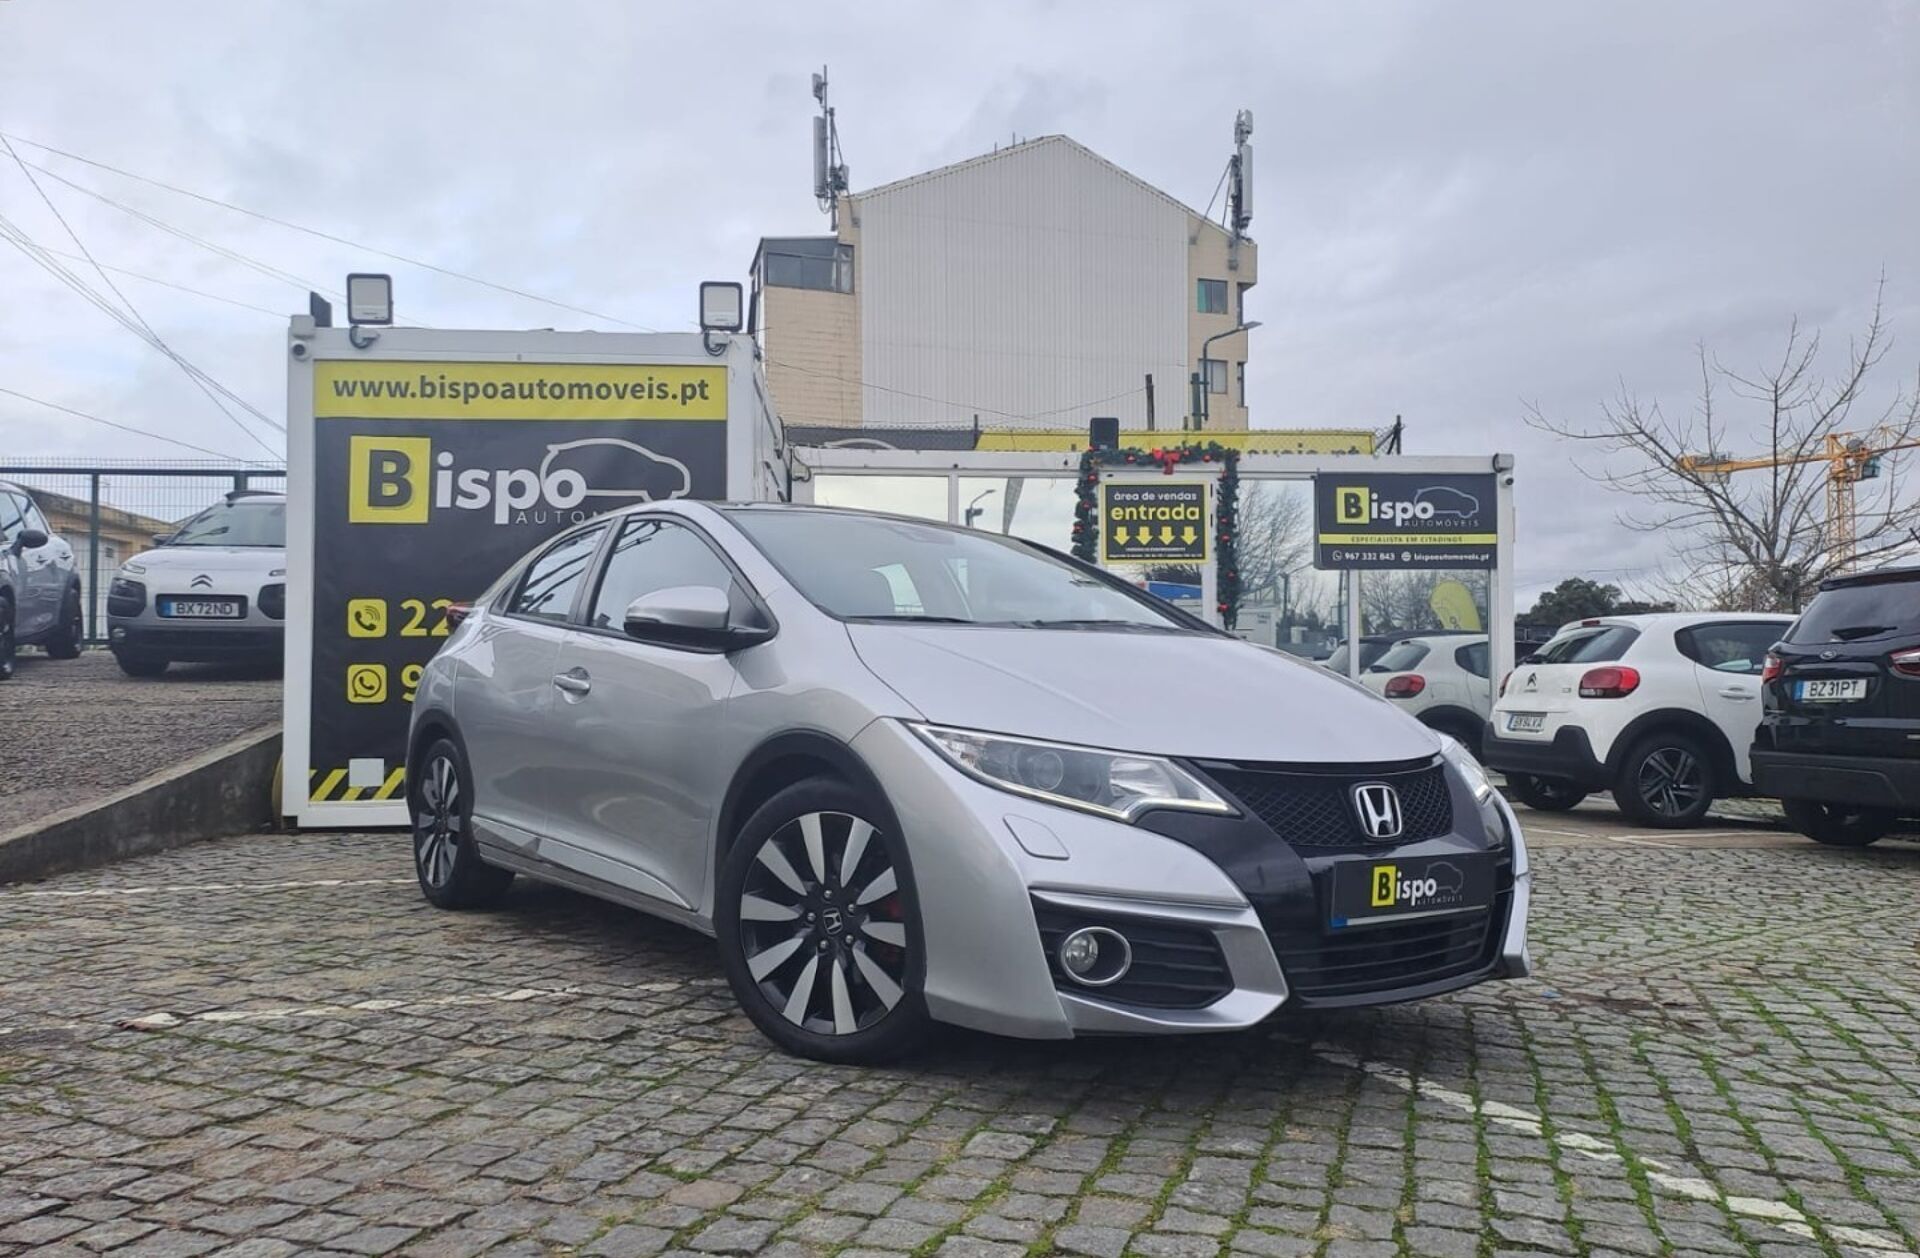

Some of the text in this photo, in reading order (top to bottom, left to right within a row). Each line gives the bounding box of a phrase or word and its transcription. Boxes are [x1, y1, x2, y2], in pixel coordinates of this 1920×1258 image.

[333, 374, 710, 405] www.bispoautomoveis.pt
[367, 448, 587, 525] Bispo
[1141, 491, 1156, 501] de
[1158, 491, 1198, 501] vendas
[1111, 503, 1200, 520] entrada
[1343, 492, 1435, 527] Bispo
[1344, 552, 1360, 561] 967
[1361, 552, 1377, 561] 332
[1414, 552, 1490, 562] bispoautomoveis.pt
[1377, 871, 1437, 906] Bispo
